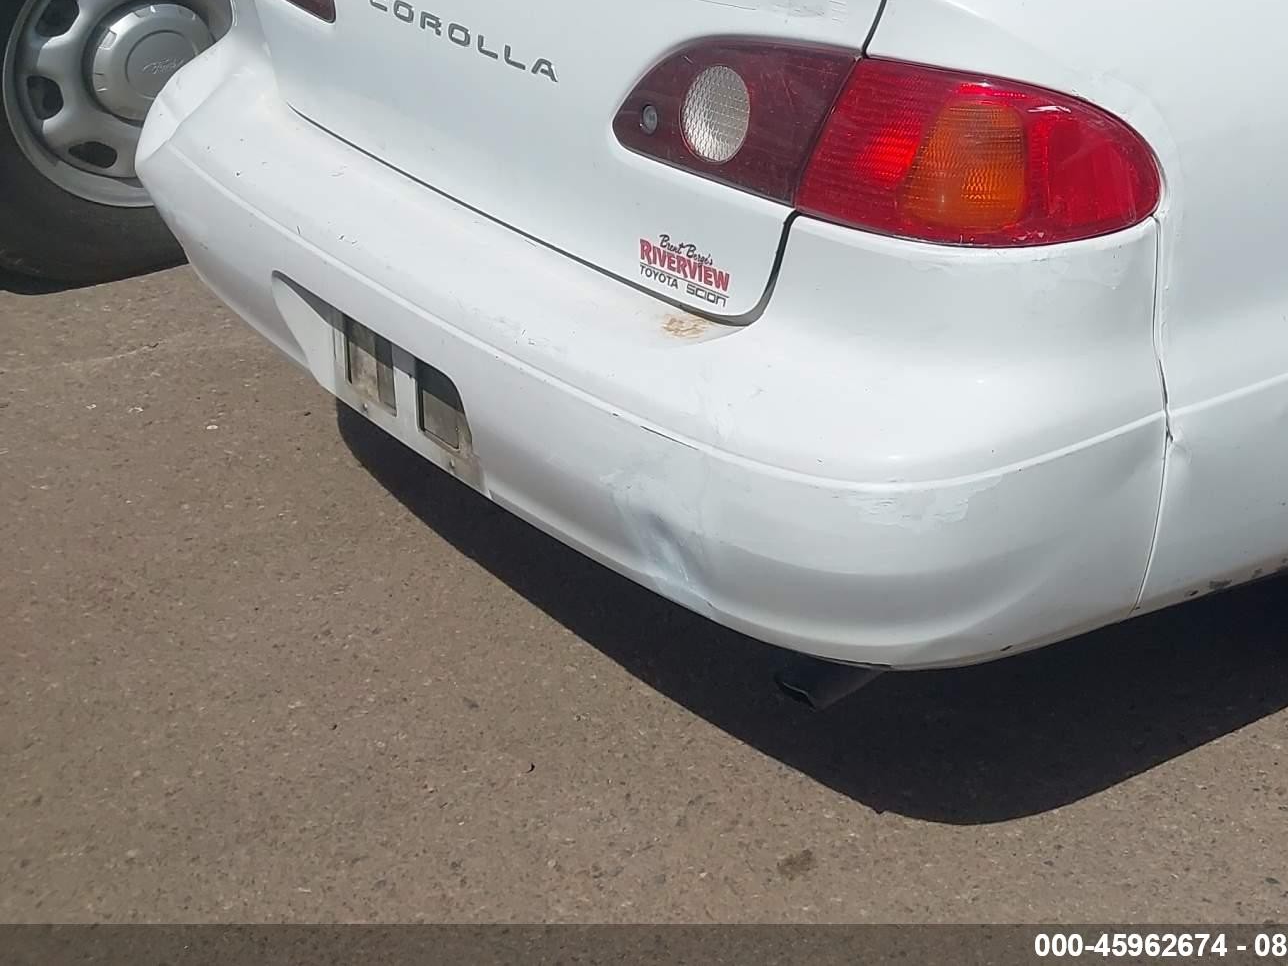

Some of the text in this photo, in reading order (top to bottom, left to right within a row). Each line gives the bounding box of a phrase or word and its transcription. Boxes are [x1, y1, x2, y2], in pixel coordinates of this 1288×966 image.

[659, 234, 686, 255] Brent
[640, 238, 730, 292] RIVERVIEW
[640, 265, 679, 289] TOYOTA
